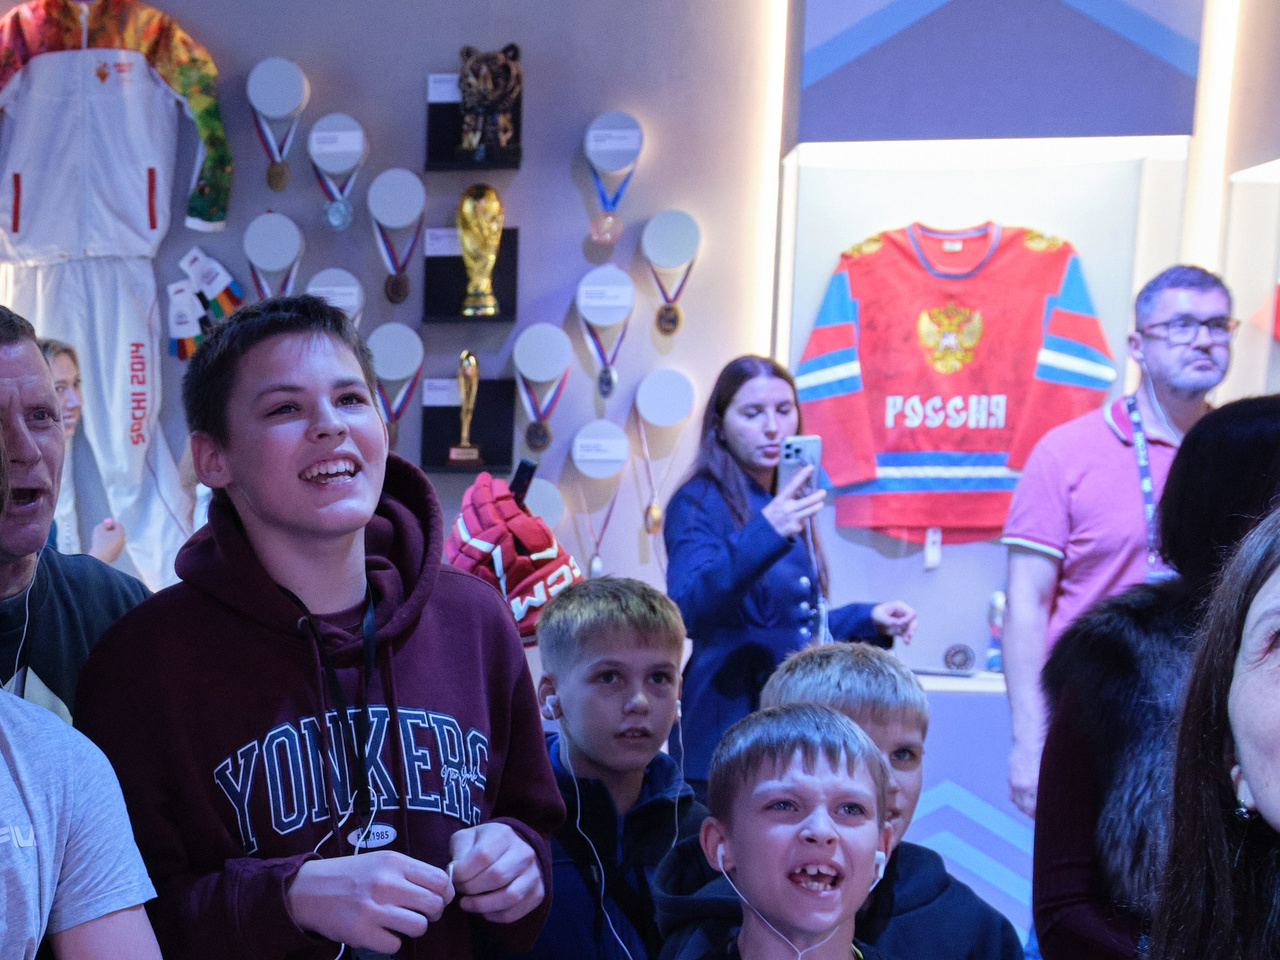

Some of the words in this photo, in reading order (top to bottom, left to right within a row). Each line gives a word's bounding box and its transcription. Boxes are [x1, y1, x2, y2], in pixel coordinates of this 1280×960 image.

[130, 342, 146, 385] 2014
[130, 392, 147, 445] SOCHI
[884, 394, 1007, 429] РОССИЯ
